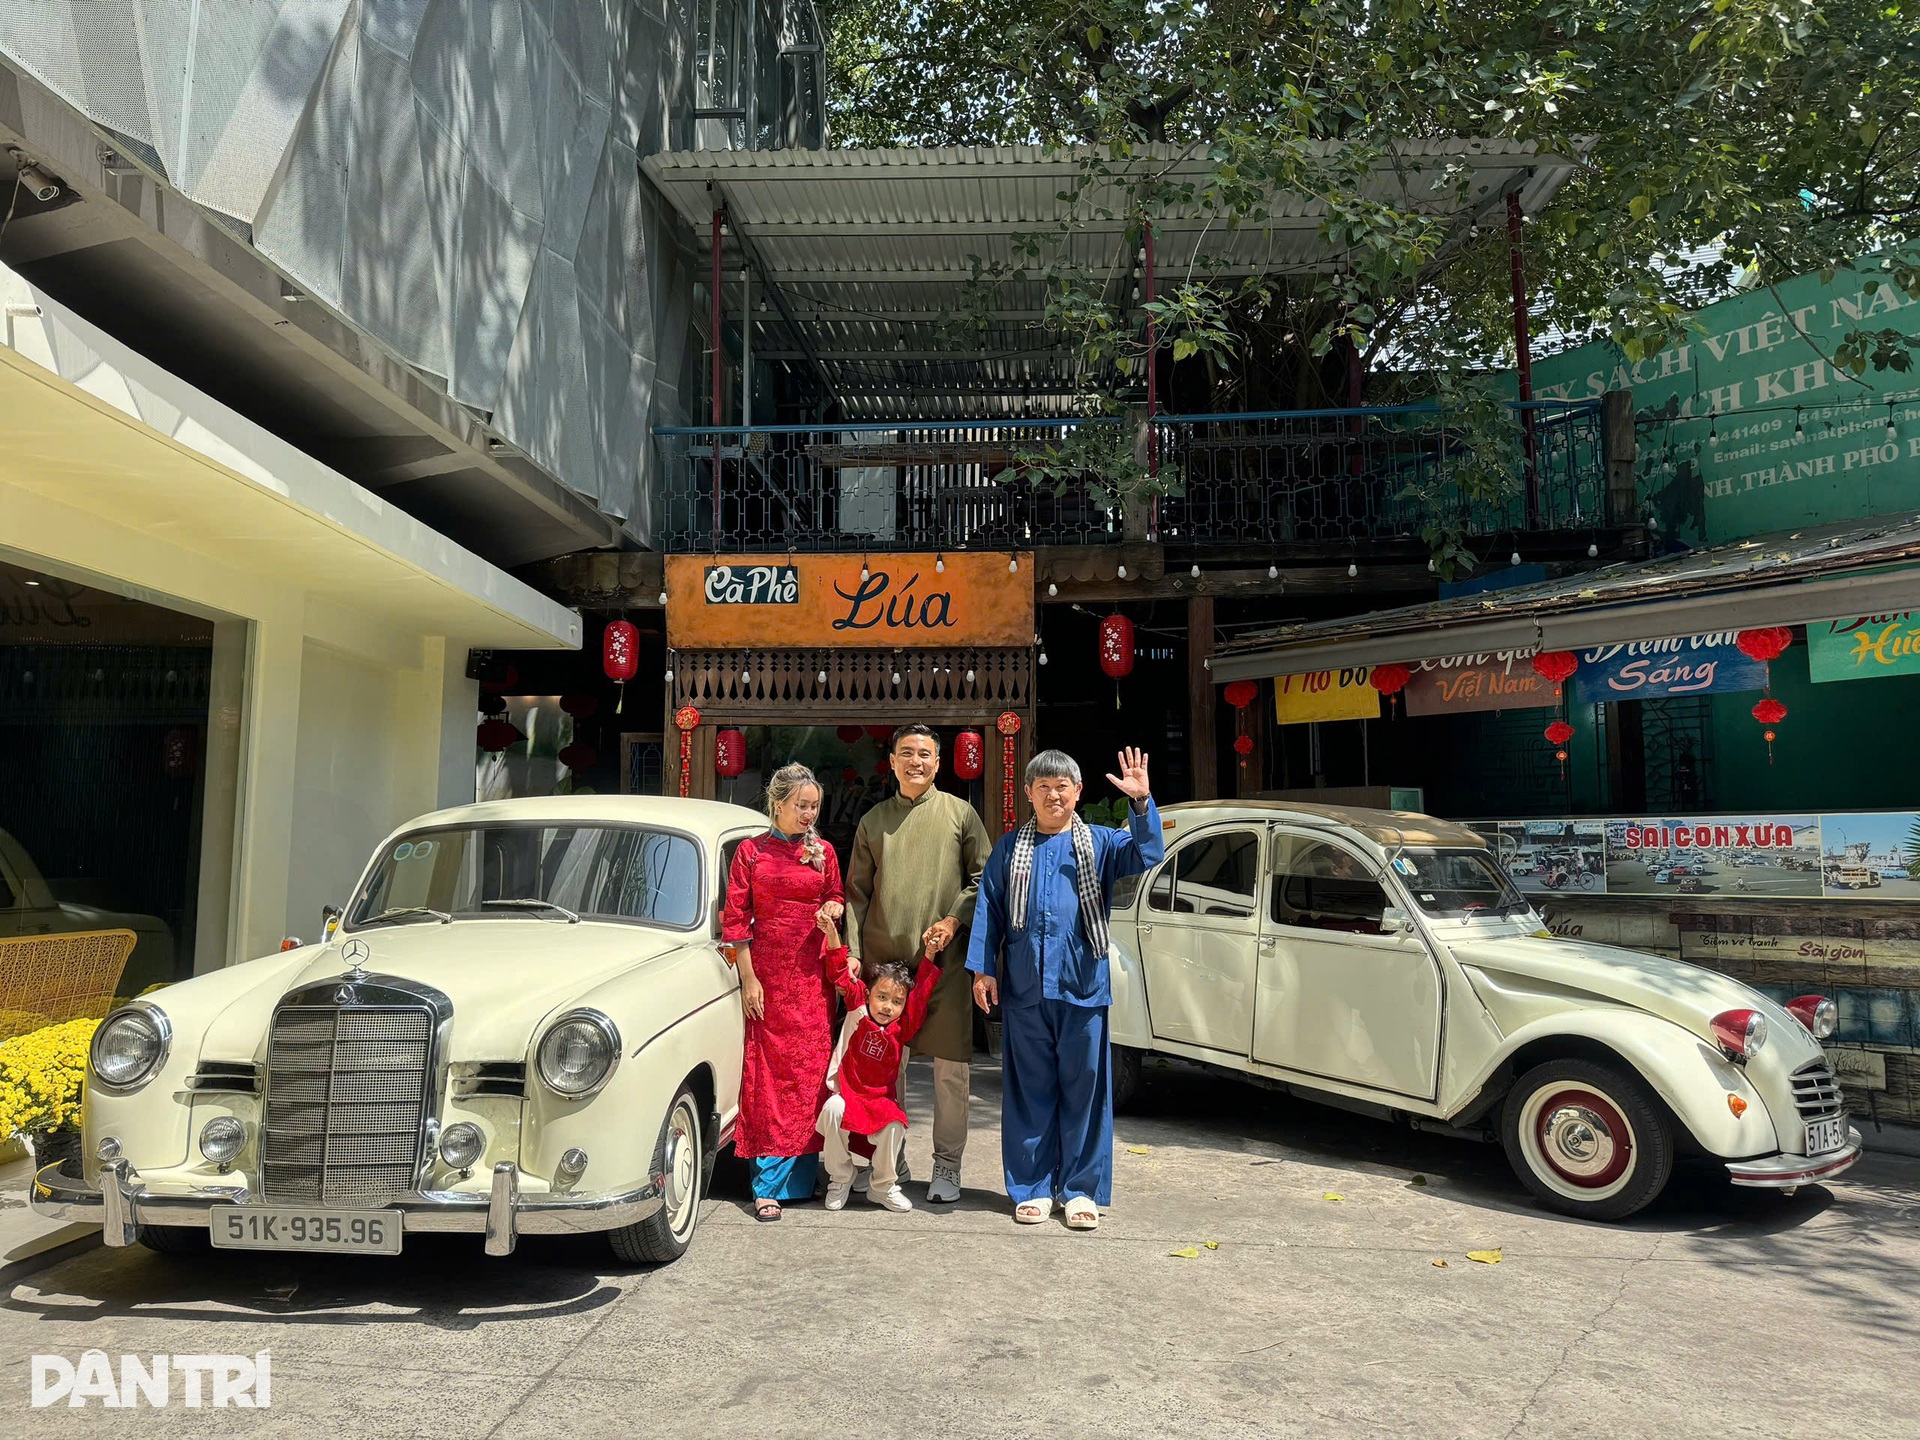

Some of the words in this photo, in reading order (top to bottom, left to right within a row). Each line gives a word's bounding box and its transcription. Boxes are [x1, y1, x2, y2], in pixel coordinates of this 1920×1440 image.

[1702, 306, 1817, 362] VIỆT
[1830, 283, 1920, 328] NA
[704, 566, 745, 603] Cà
[746, 566, 798, 603] Phê
[832, 572, 958, 630] Lúa
[1435, 671, 1485, 702] Việt
[1489, 671, 1543, 695] Nam
[1608, 655, 1718, 691] Sáng
[1749, 937, 1778, 947] tranh
[227, 1213, 384, 1245] 51K-935.96
